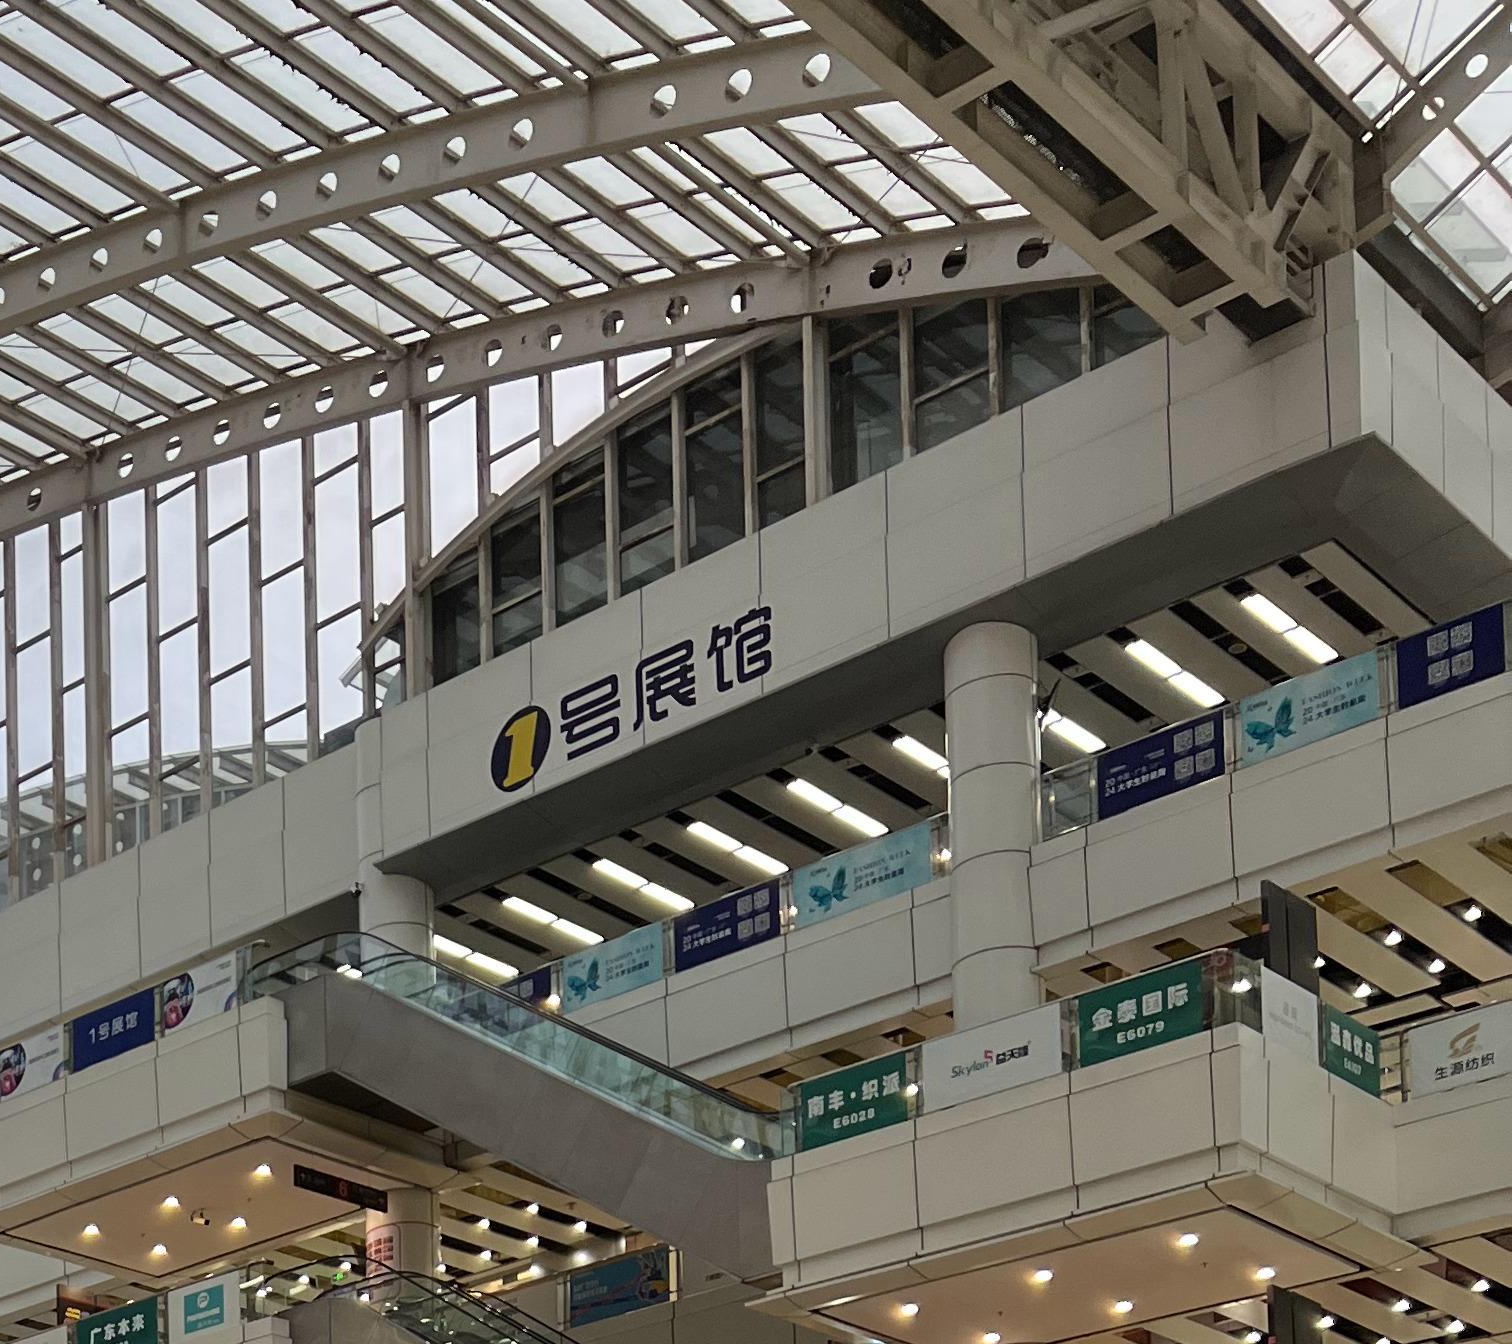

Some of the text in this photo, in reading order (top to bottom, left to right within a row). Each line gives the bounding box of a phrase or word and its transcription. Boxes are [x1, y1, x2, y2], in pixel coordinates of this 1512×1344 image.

[1091, 982, 1188, 1032] 金泰国际
[87, 1009, 139, 1045] 1号展馆
[1116, 1020, 1165, 1044] E6079
